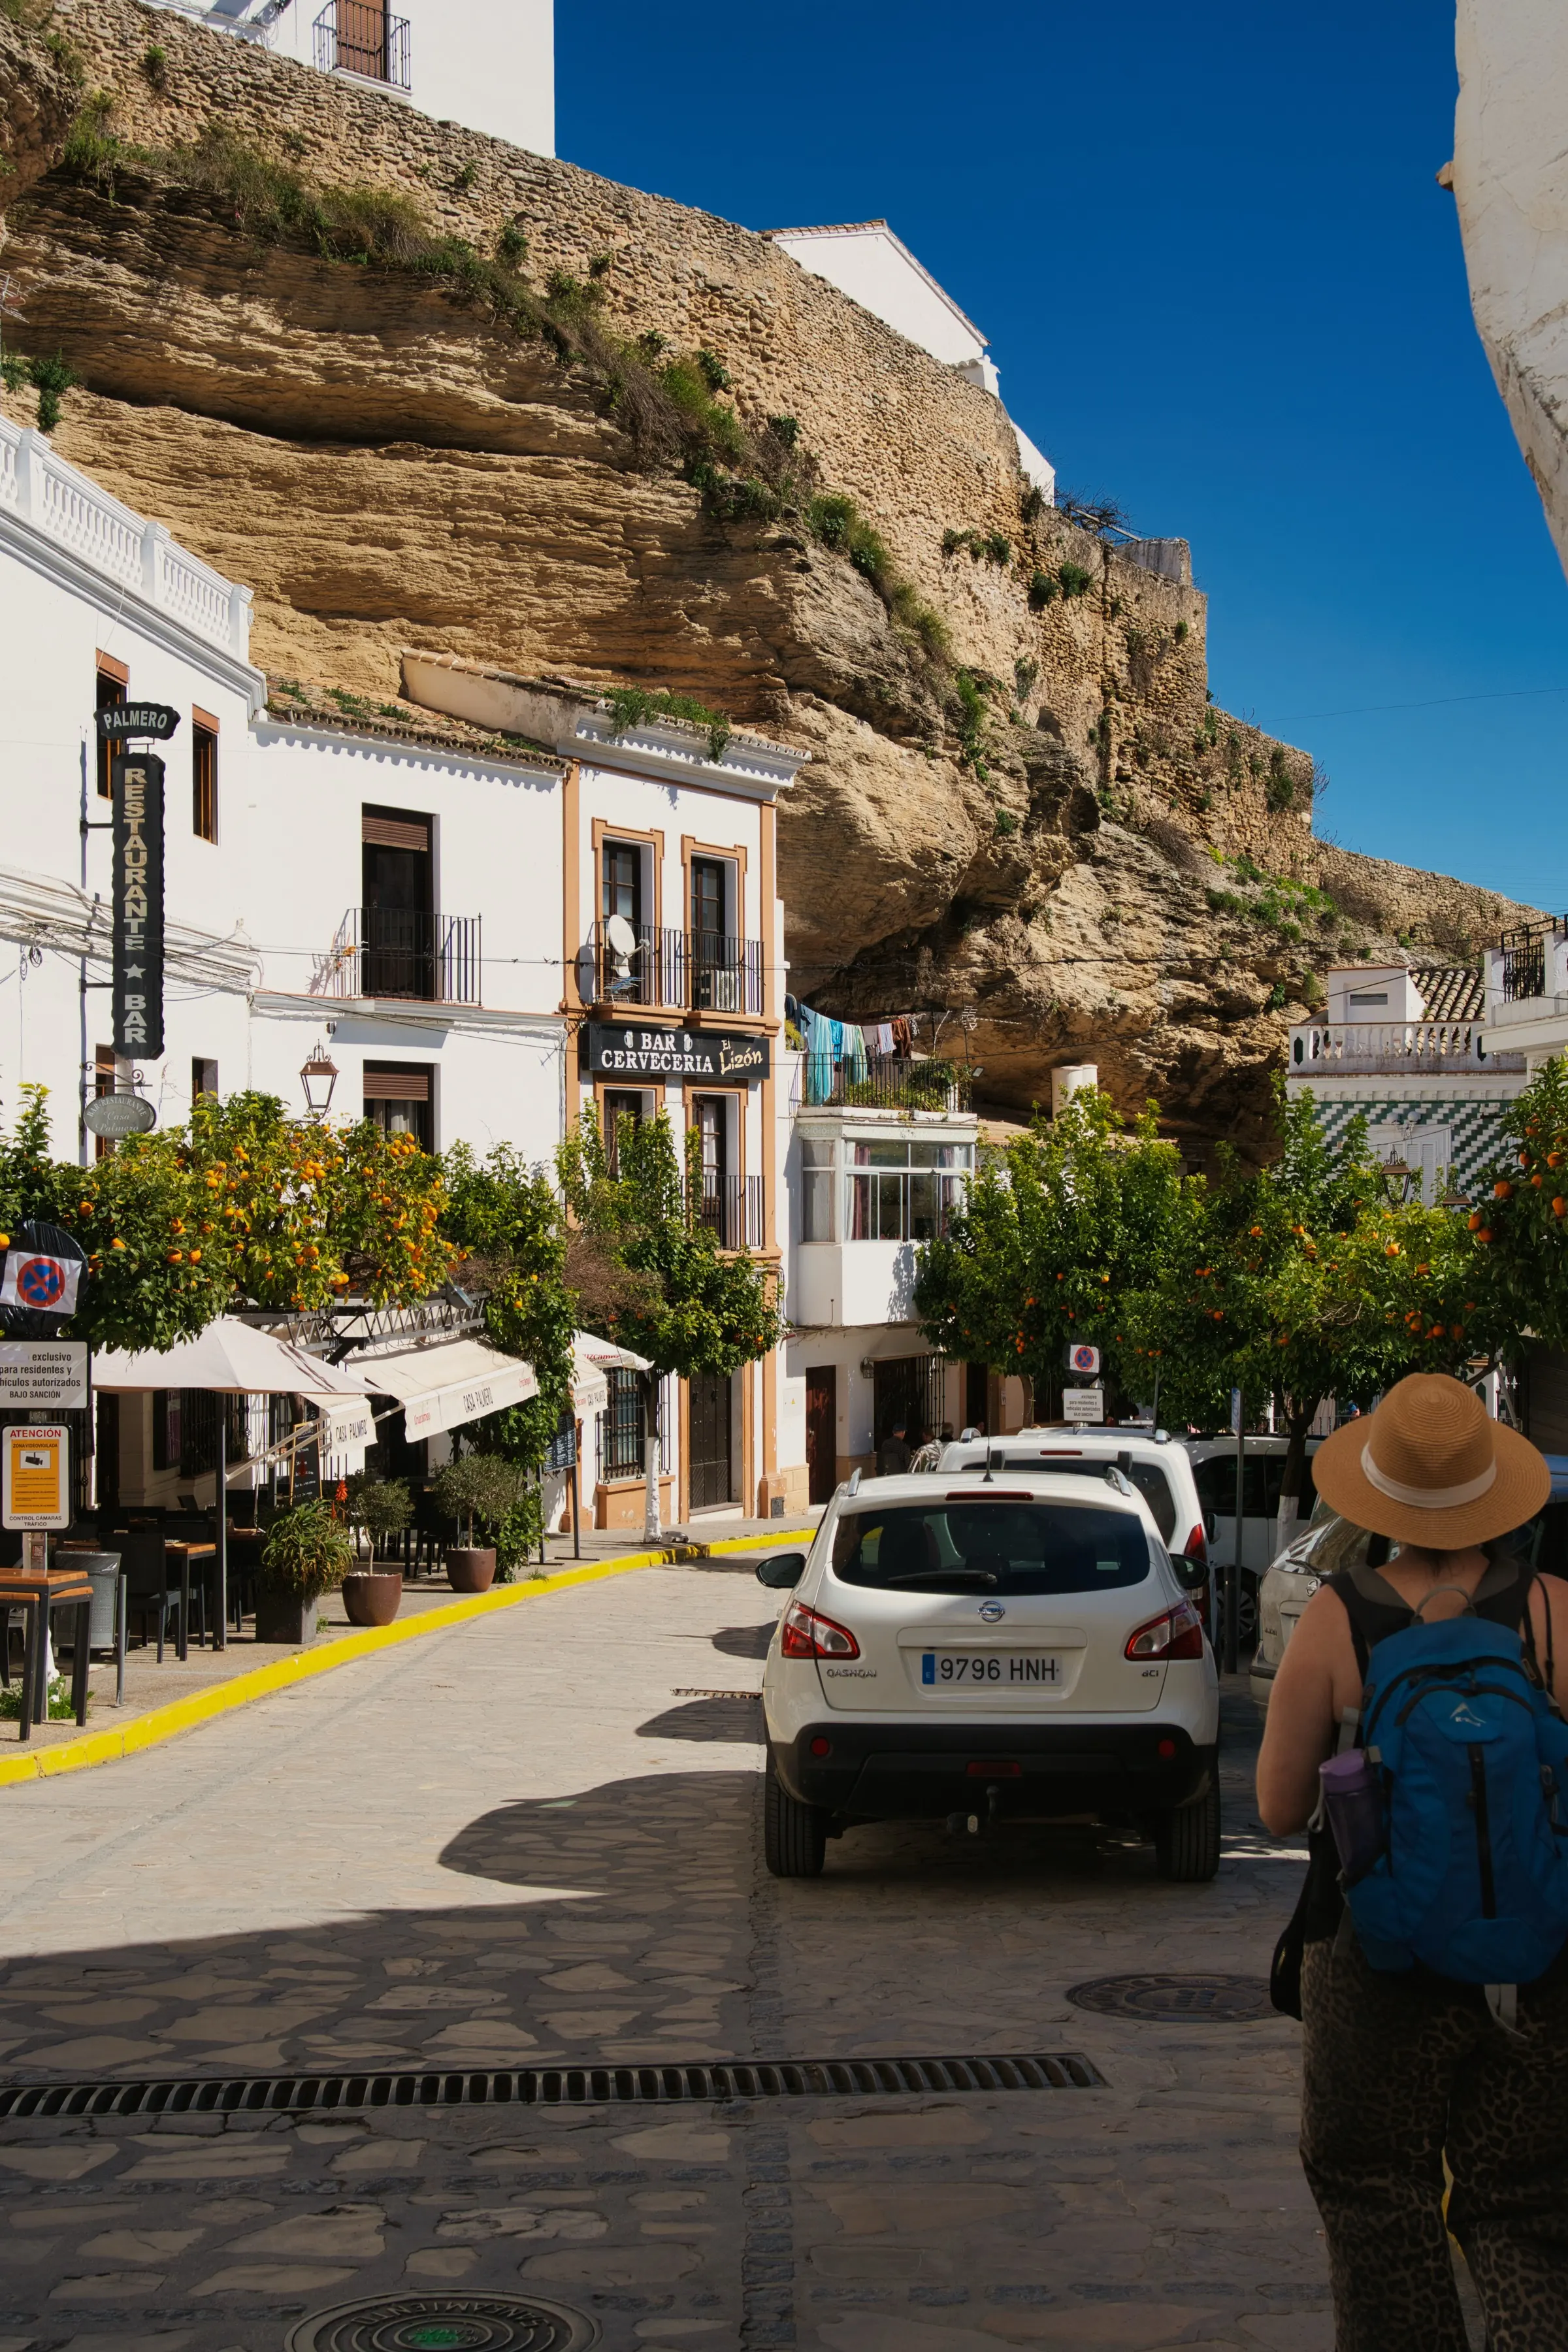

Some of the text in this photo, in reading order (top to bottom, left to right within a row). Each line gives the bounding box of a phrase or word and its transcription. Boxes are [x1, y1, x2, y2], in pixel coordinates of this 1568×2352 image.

[103, 710, 168, 730] PALMERO
[123, 768, 147, 951] RESTAURANTE
[123, 994, 147, 1043] BAR
[641, 1032, 677, 1052] BAR
[721, 1038, 731, 1051] El
[601, 1049, 713, 1073] CERVECERIA
[719, 1047, 763, 1075] Lizón
[103, 1111, 130, 1121] Casa
[95, 1122, 139, 1133] Palmero
[32, 1352, 72, 1361] exclusivo
[0, 1365, 72, 1376] para residentes y
[32, 1378, 80, 1386] autorizados
[29, 1389, 61, 1398] SANCIÓN
[463, 1387, 494, 1413] CASA PALMERO
[10, 1426, 62, 1438] ATENCIÓN
[336, 1425, 347, 1443] CASA
[826, 1669, 877, 1678] QASHQAI
[940, 1658, 1000, 1680] 9796
[1010, 1658, 1054, 1680] HNH
[350, 2301, 551, 2328] SANEAMIENTO
